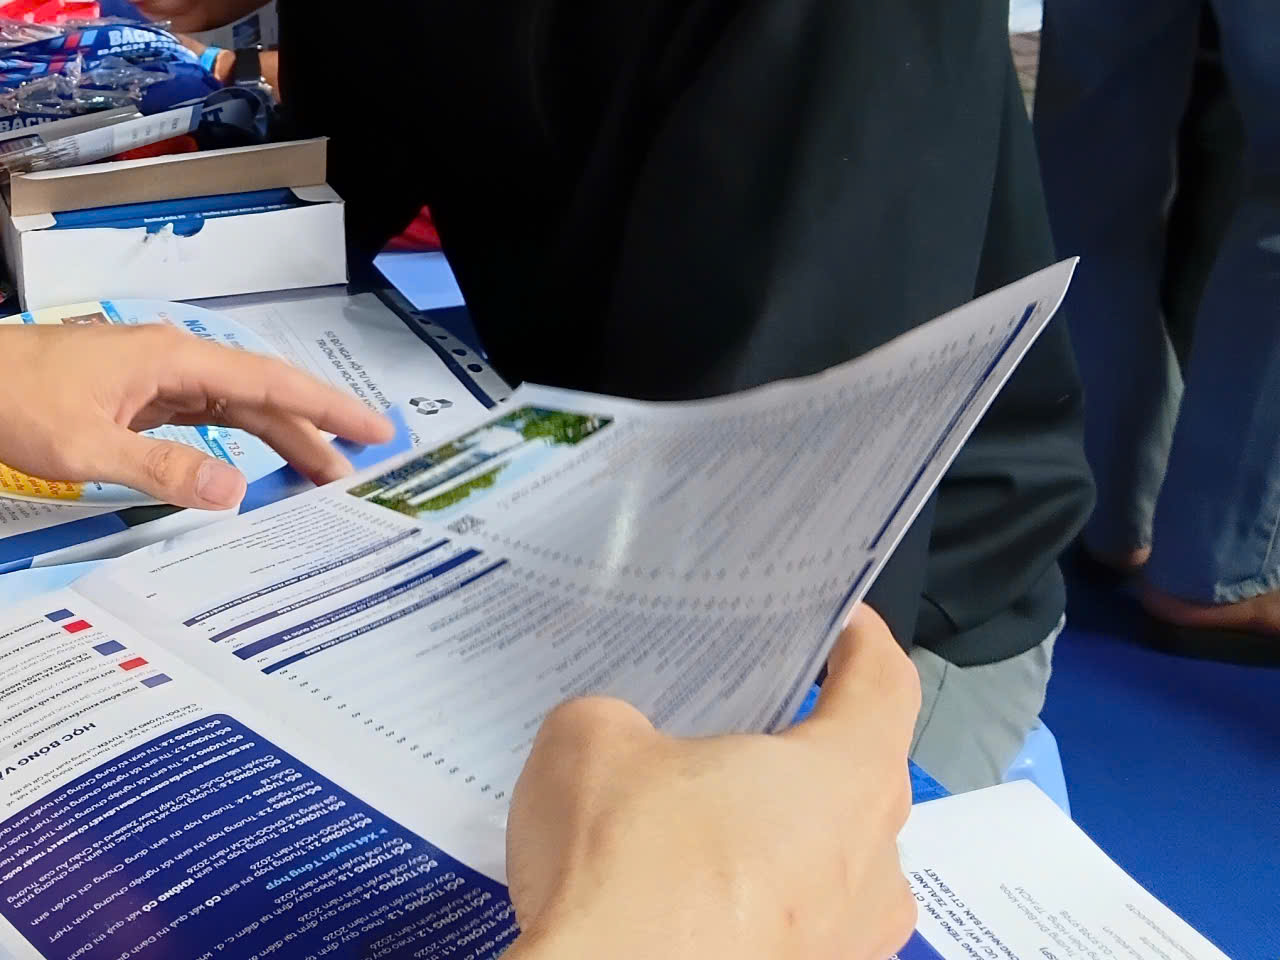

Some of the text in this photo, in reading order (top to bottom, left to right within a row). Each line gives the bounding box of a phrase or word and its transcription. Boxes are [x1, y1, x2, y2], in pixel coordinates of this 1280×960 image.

[61, 721, 97, 743] HỌC
[65, 776, 98, 796] Chứng
[27, 800, 56, 819] tuyển
[200, 802, 235, 821] Trường
[222, 814, 257, 834] Trường
[243, 831, 279, 851] Trường
[270, 848, 306, 868] Trường
[319, 841, 357, 862] tuyển
[247, 855, 275, 870] 2026
[91, 862, 126, 885] Chứng
[127, 866, 162, 889] nghiệp
[92, 885, 131, 911] chương
[156, 876, 195, 902] KHÔNG
[49, 892, 78, 913] tuyển
[47, 923, 73, 942] THPT
[65, 941, 94, 960] Đánh
[128, 934, 157, 954] Đánh
